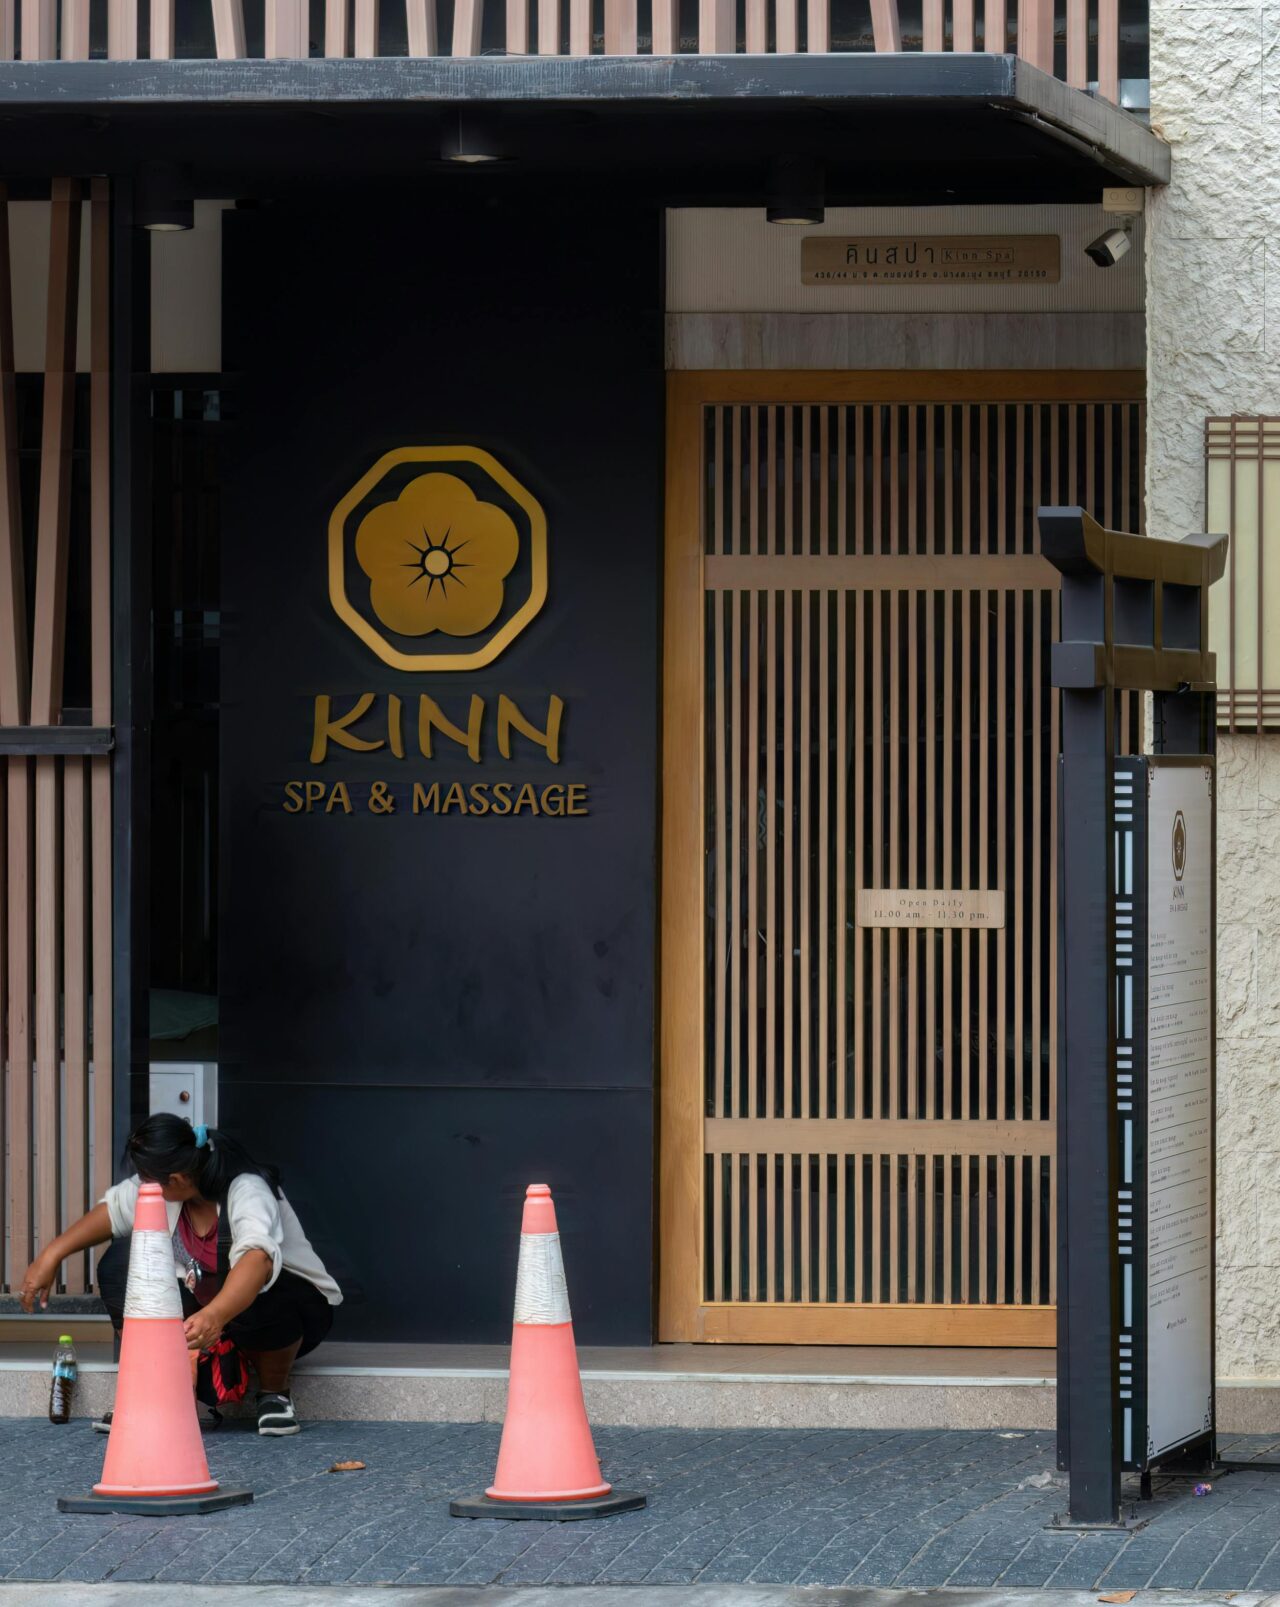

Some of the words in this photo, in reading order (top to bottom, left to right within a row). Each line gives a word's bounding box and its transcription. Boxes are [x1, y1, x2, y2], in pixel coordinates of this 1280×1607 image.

[945, 250, 978, 261] Kinn
[986, 250, 1011, 263] Spa
[309, 692, 565, 764] KINN
[283, 781, 352, 814] SPA
[368, 781, 395, 814] &
[413, 783, 589, 816] MASSAGE
[899, 899, 927, 907] Open
[933, 899, 963, 907] Daily
[874, 910, 901, 918] 11.00
[937, 910, 964, 918] 11.30
[969, 911, 990, 921] pm.
